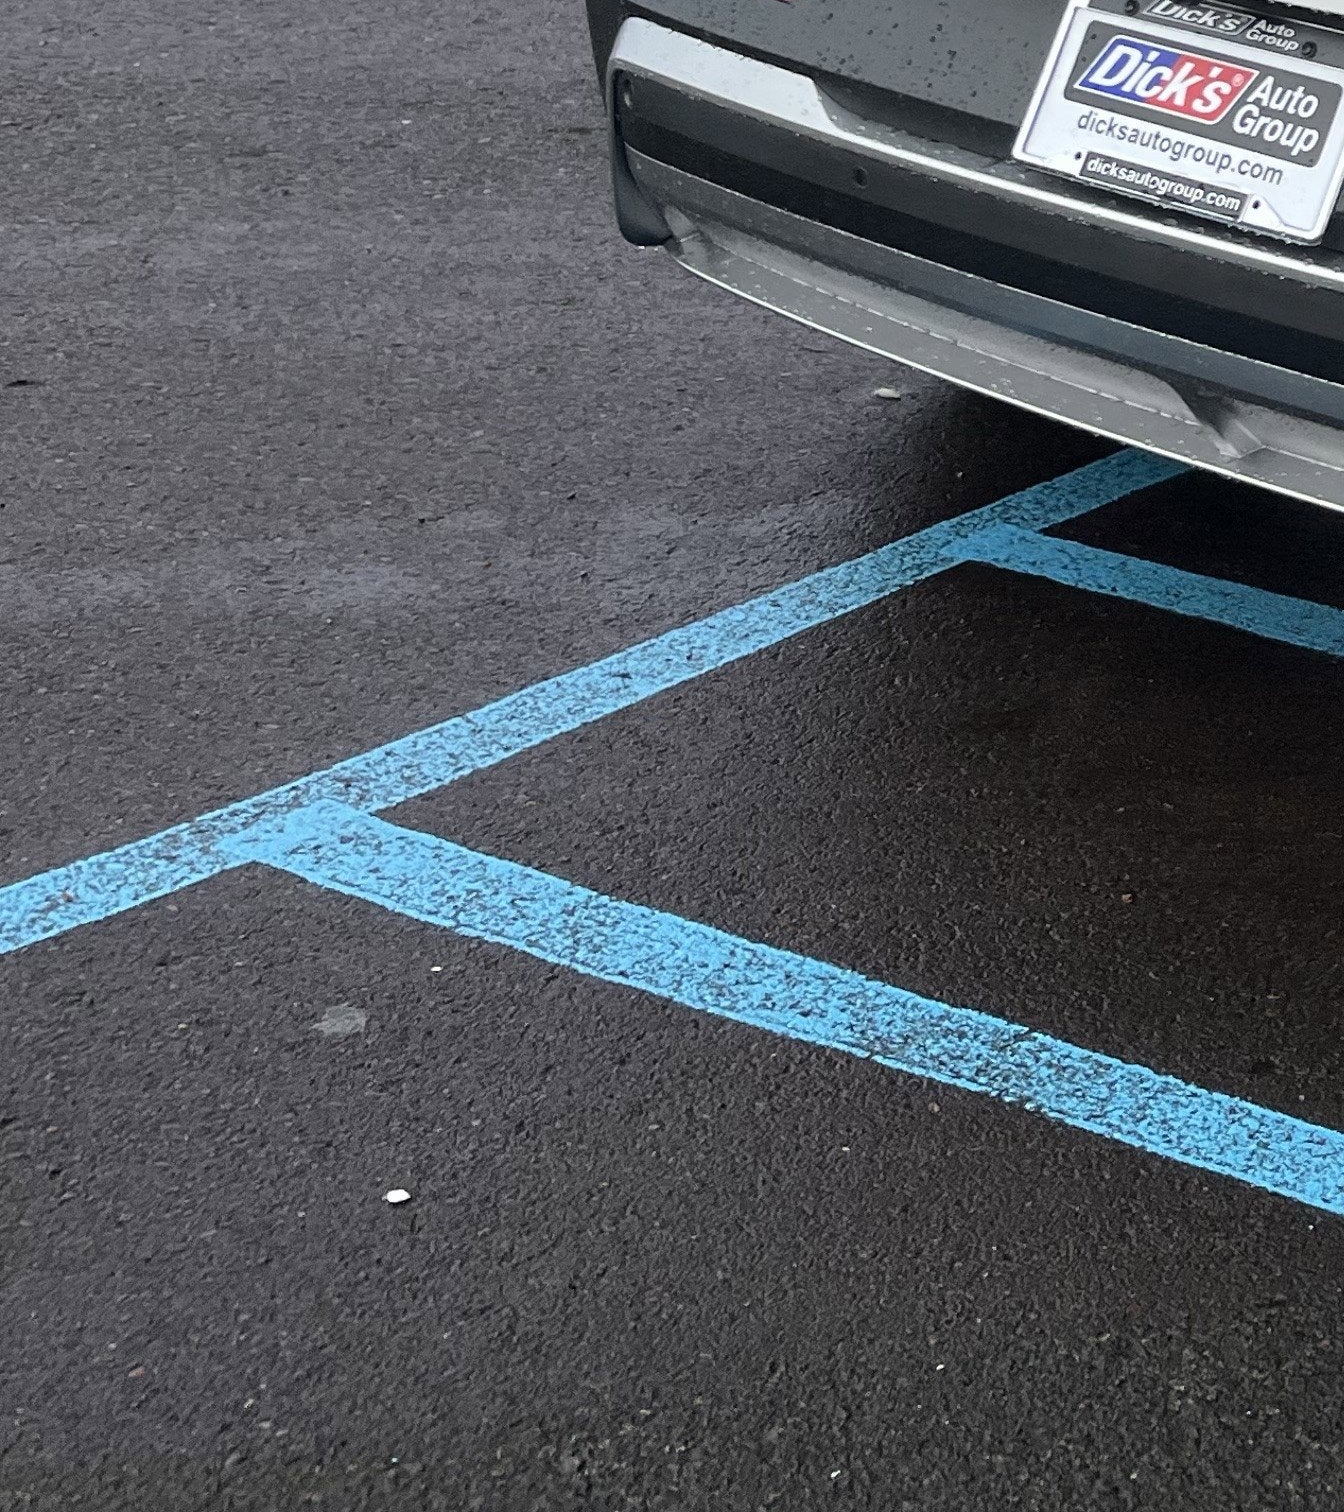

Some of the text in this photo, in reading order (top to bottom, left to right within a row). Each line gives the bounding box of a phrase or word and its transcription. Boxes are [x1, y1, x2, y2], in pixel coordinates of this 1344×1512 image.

[1152, 0, 1241, 32] Dick's
[1251, 19, 1296, 38] Auto
[1246, 30, 1300, 51] Group
[1088, 44, 1233, 114] Dick's
[1247, 75, 1319, 119] Auto
[1077, 110, 1284, 186] dicksautogroup.com
[1232, 104, 1319, 156] Group
[1087, 157, 1240, 212] dicksautogroup.com
